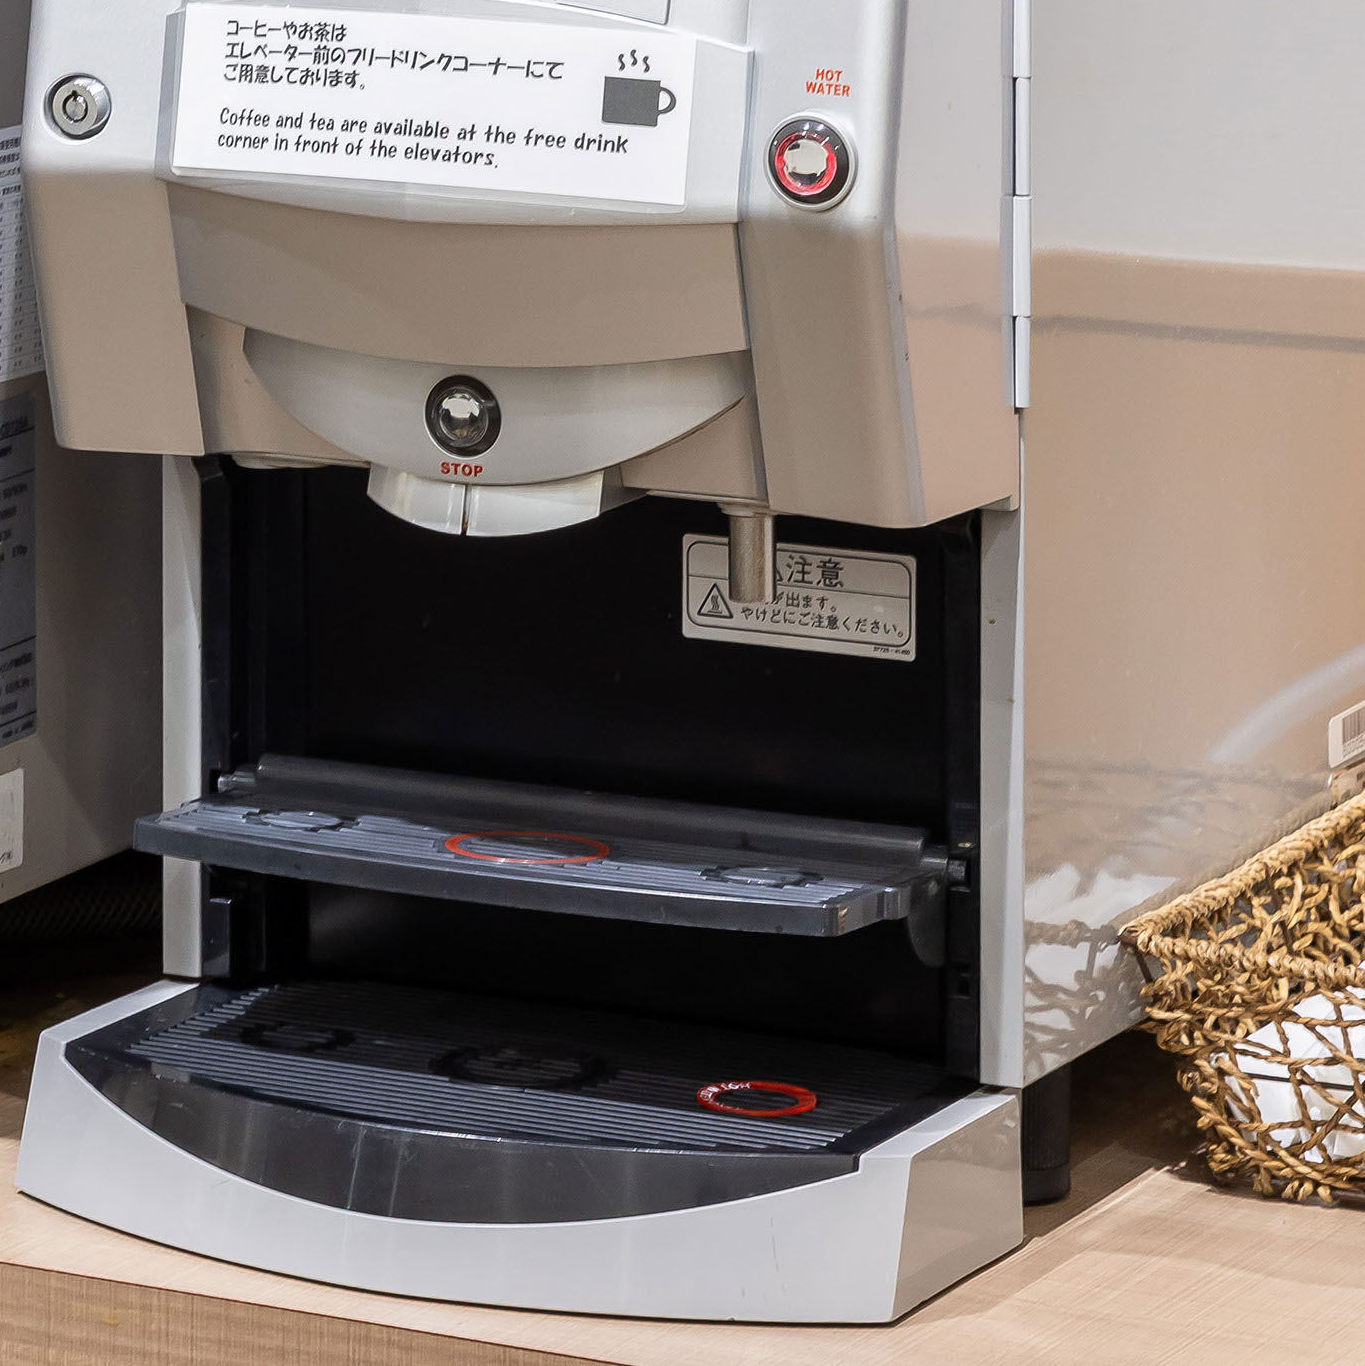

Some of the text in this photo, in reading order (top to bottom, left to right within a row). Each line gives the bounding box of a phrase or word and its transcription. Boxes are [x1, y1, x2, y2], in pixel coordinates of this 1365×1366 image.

[226, 20, 347, 43] コーヒーやお茶は
[225, 42, 565, 79] エレベーター前のフリードリンクコーナーにて
[815, 68, 843, 82] HOT
[223, 63, 366, 91] ご用意しております。
[805, 81, 851, 97] WATER
[219, 107, 629, 154] Coffee and tea are available at the free drink
[218, 133, 499, 169] corner in front of the elevators.
[440, 461, 483, 477] STOP
[785, 554, 845, 588] 注意
[740, 605, 905, 638] やけどにご注意ください。
